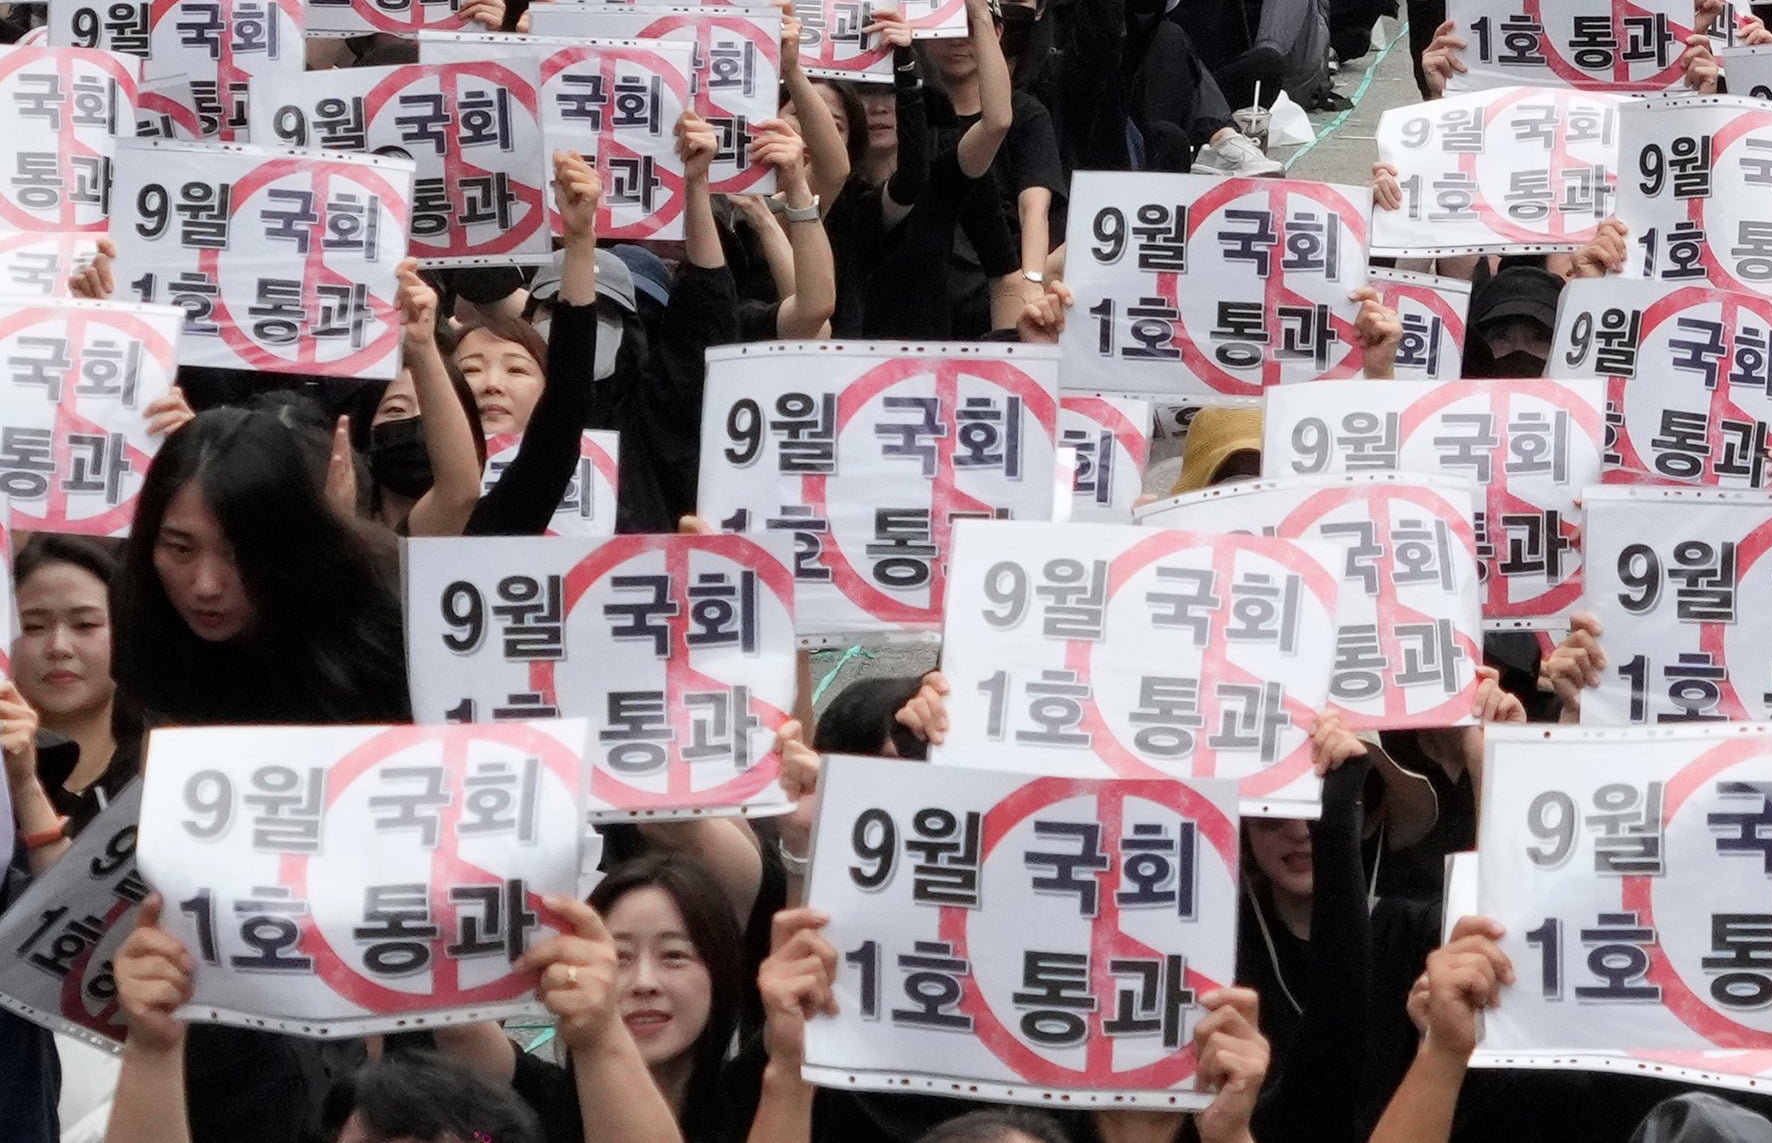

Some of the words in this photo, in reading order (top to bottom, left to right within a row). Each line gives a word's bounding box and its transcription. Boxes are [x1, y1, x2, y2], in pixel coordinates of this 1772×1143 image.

[1468, 13, 1548, 69] 1호
[1568, 12, 1675, 71] 통과
[555, 72, 661, 137] 국회
[1401, 106, 1486, 155] 9월
[1510, 104, 1614, 149] 국회
[133, 180, 233, 251] 9월
[258, 187, 381, 262] 국회
[1401, 171, 1480, 222] 1호
[1503, 164, 1616, 222] 통과
[1090, 202, 1189, 275] 9월
[1215, 206, 1342, 282] 국회
[1637, 220, 1708, 282] 1호
[722, 390, 840, 475] 9월
[873, 394, 1024, 481] 국회
[439, 572, 562, 662] 9월
[602, 566, 759, 657] 국회
[981, 556, 1111, 642] 9월
[1145, 565, 1304, 655] 국회
[1616, 539, 1739, 626] 9월
[599, 683, 761, 776] 통과
[976, 668, 1093, 750] 1호
[1128, 672, 1294, 762] 통과
[180, 762, 328, 855] 9월
[366, 756, 542, 851] 국회
[1523, 779, 1668, 878] 9월
[848, 806, 984, 912] 9월
[1023, 817, 1200, 921] 국회
[179, 884, 315, 975] 1호
[352, 877, 540, 979] 통과
[1524, 911, 1662, 1005] 1호
[845, 937, 974, 1034] 1호
[1011, 948, 1200, 1050] 통과
